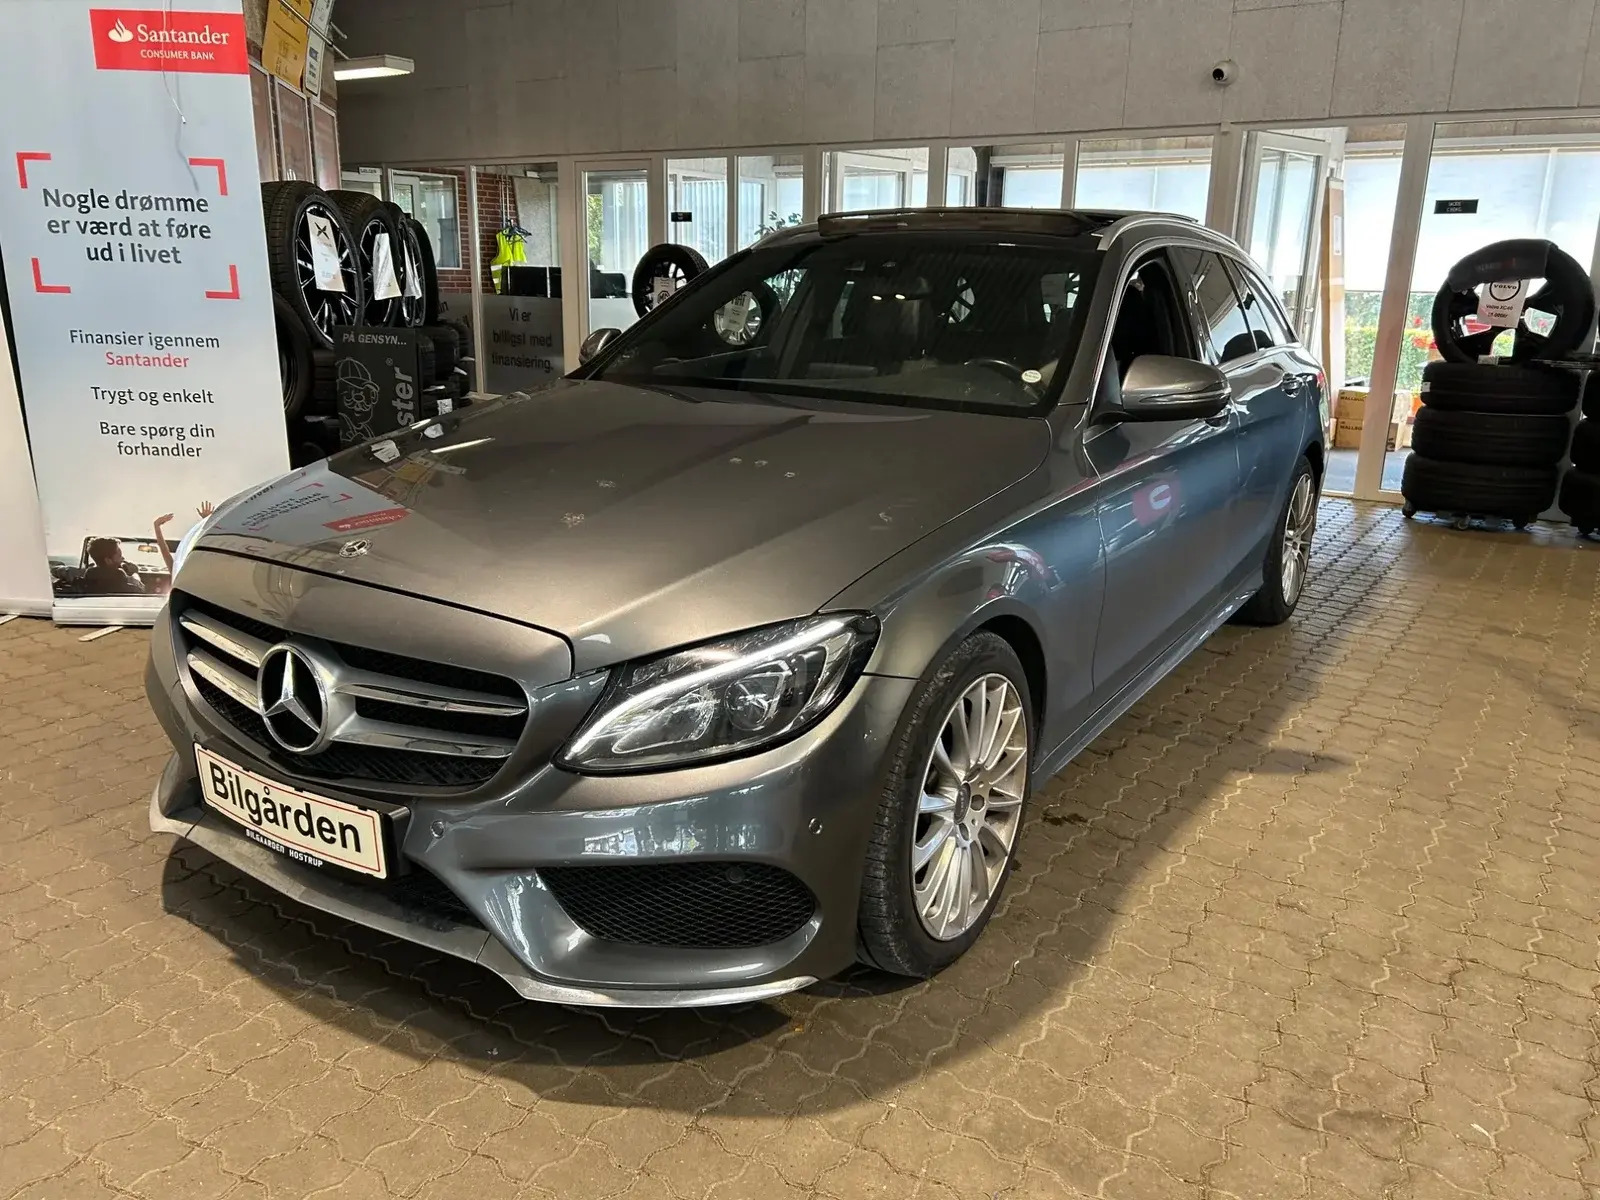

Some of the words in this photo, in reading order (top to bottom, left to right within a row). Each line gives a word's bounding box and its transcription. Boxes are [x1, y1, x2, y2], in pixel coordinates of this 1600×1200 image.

[137, 23, 229, 45] Santander
[140, 49, 189, 59] CONSUMER
[191, 51, 215, 60] BANK
[42, 188, 109, 214] Nogle
[115, 190, 209, 212] drømme
[47, 219, 70, 234] er
[76, 216, 132, 236] værd
[139, 219, 161, 237] at
[166, 219, 212, 239] føre
[86, 243, 113, 261] ud
[119, 244, 125, 262] i
[132, 244, 182, 264] livet
[509, 307, 519, 321] Vi
[521, 312, 532, 321] er
[70, 329, 143, 346] Finansier
[149, 332, 220, 350] igennem
[342, 331, 355, 343] PÅ
[492, 329, 526, 347] billigst
[530, 332, 552, 347] med
[106, 352, 189, 368] Santander
[91, 386, 135, 405] Trygt
[138, 391, 159, 405] og
[163, 389, 215, 404] enkelt
[392, 366, 415, 426] ster
[100, 421, 136, 436] Bare
[140, 425, 186, 441] spørg
[189, 423, 215, 438] din
[117, 442, 202, 457] forhandler
[209, 760, 362, 853] Bilgården
[245, 828, 285, 854] BILGAARDEN
[289, 849, 324, 868] HOSTRUP
